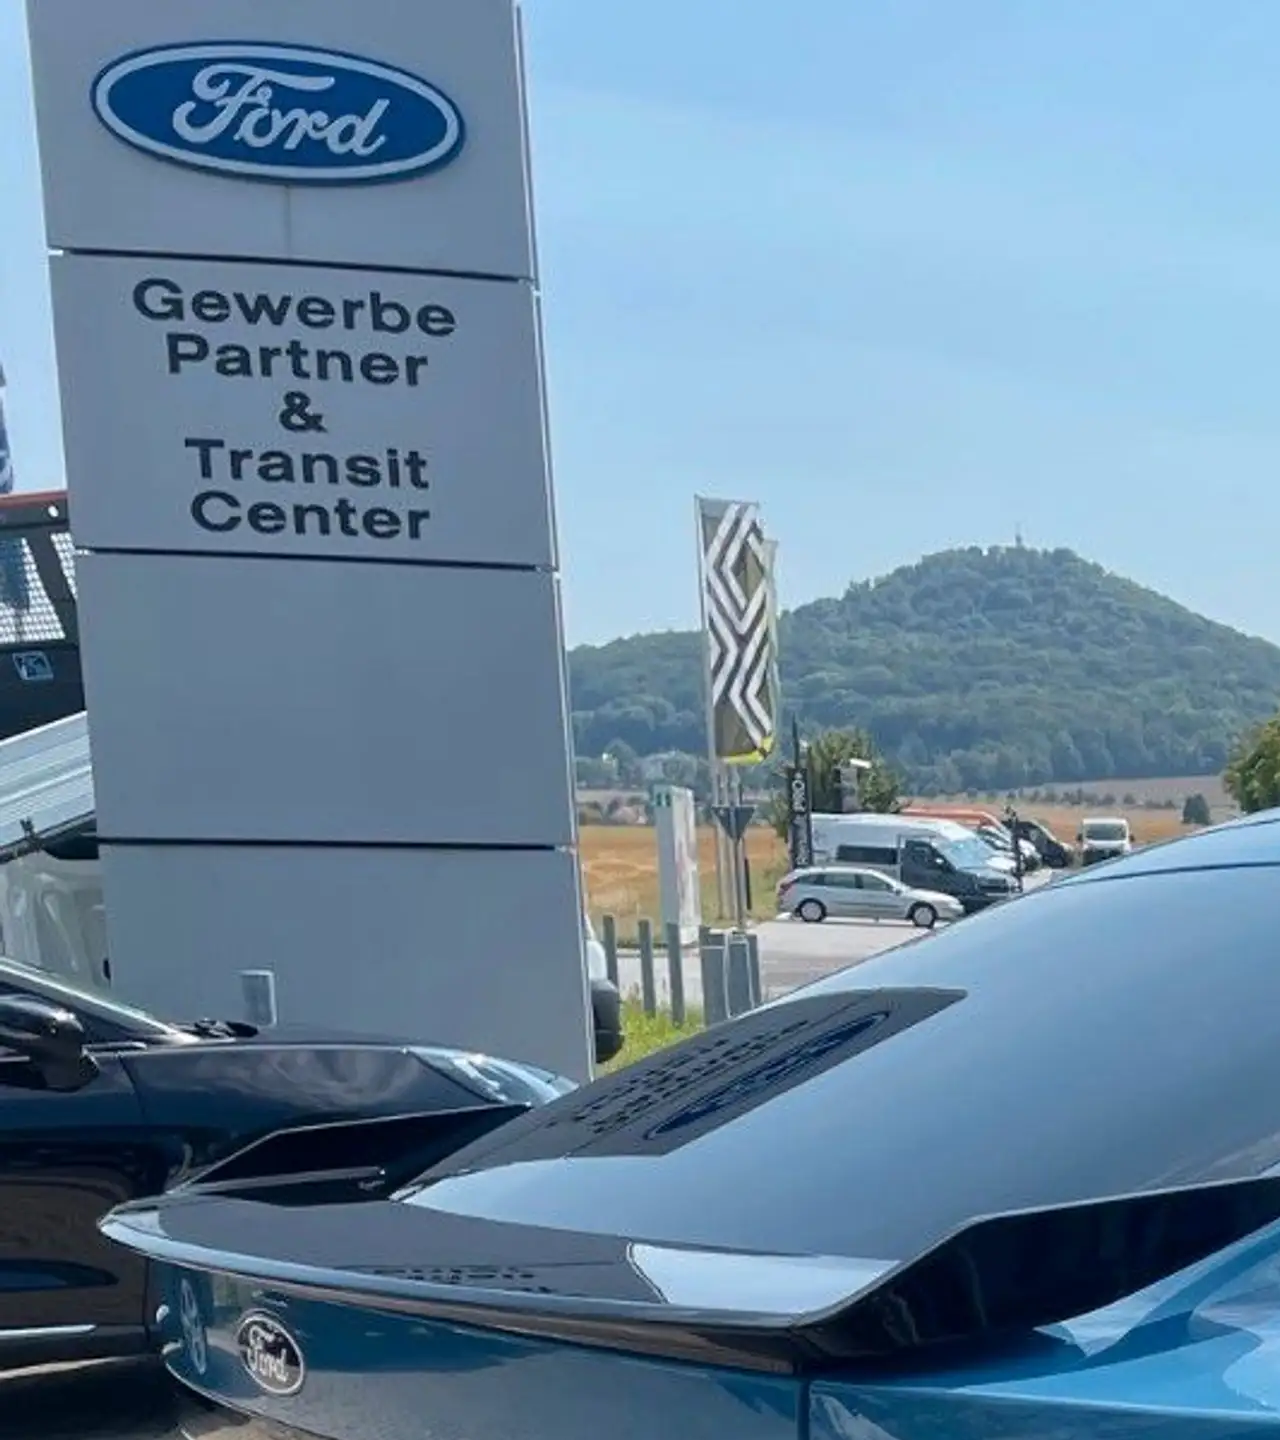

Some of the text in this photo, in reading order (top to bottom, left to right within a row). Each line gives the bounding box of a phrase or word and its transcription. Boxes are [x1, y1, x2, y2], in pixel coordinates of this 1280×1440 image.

[172, 63, 390, 156] Ford
[133, 278, 456, 338] Gewerbe
[166, 332, 429, 387] Partner
[279, 391, 328, 433] &
[185, 437, 430, 490] Transit
[190, 490, 431, 541] Center
[247, 1325, 290, 1384] Ford
